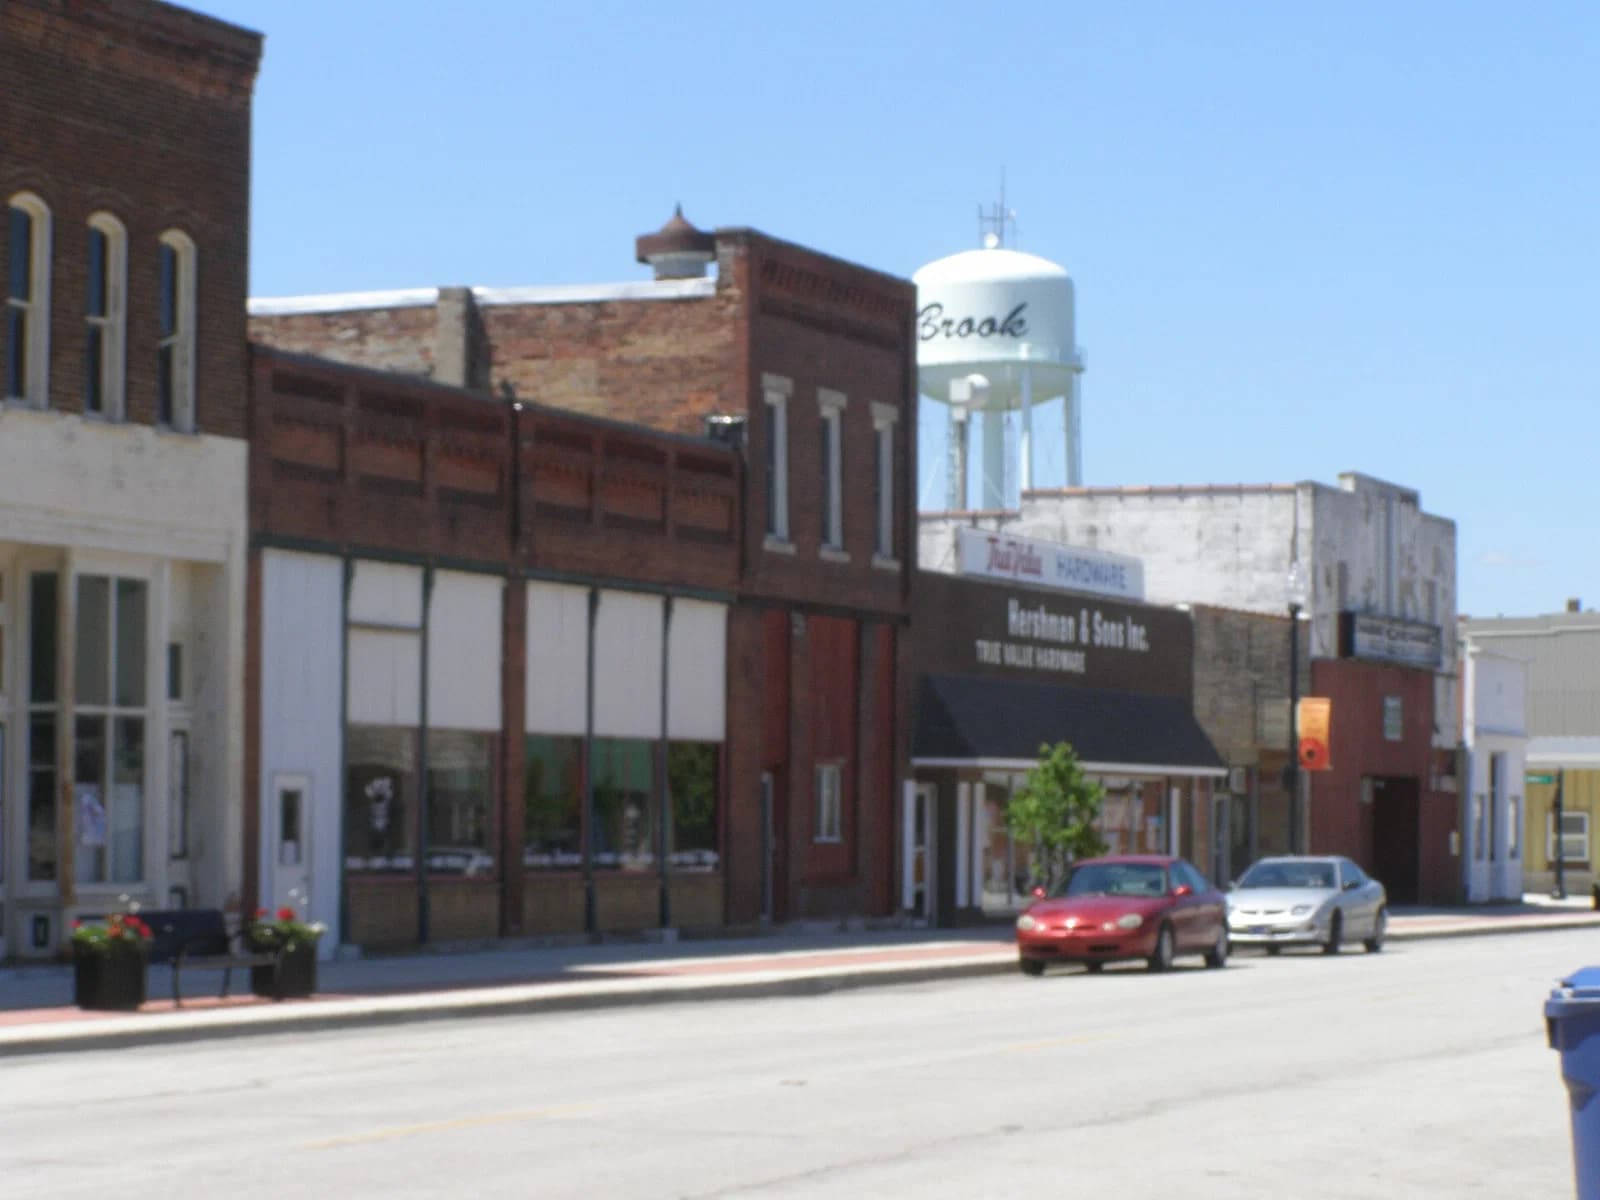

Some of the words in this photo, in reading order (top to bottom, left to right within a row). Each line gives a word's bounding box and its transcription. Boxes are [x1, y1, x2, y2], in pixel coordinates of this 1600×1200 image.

[917, 302, 1028, 341] Brook
[1055, 551, 1127, 590] HARDWARE
[1008, 598, 1075, 643] Hershman
[1080, 608, 1089, 644] &
[1093, 610, 1124, 648] Sons
[1126, 615, 1150, 652] Inc.
